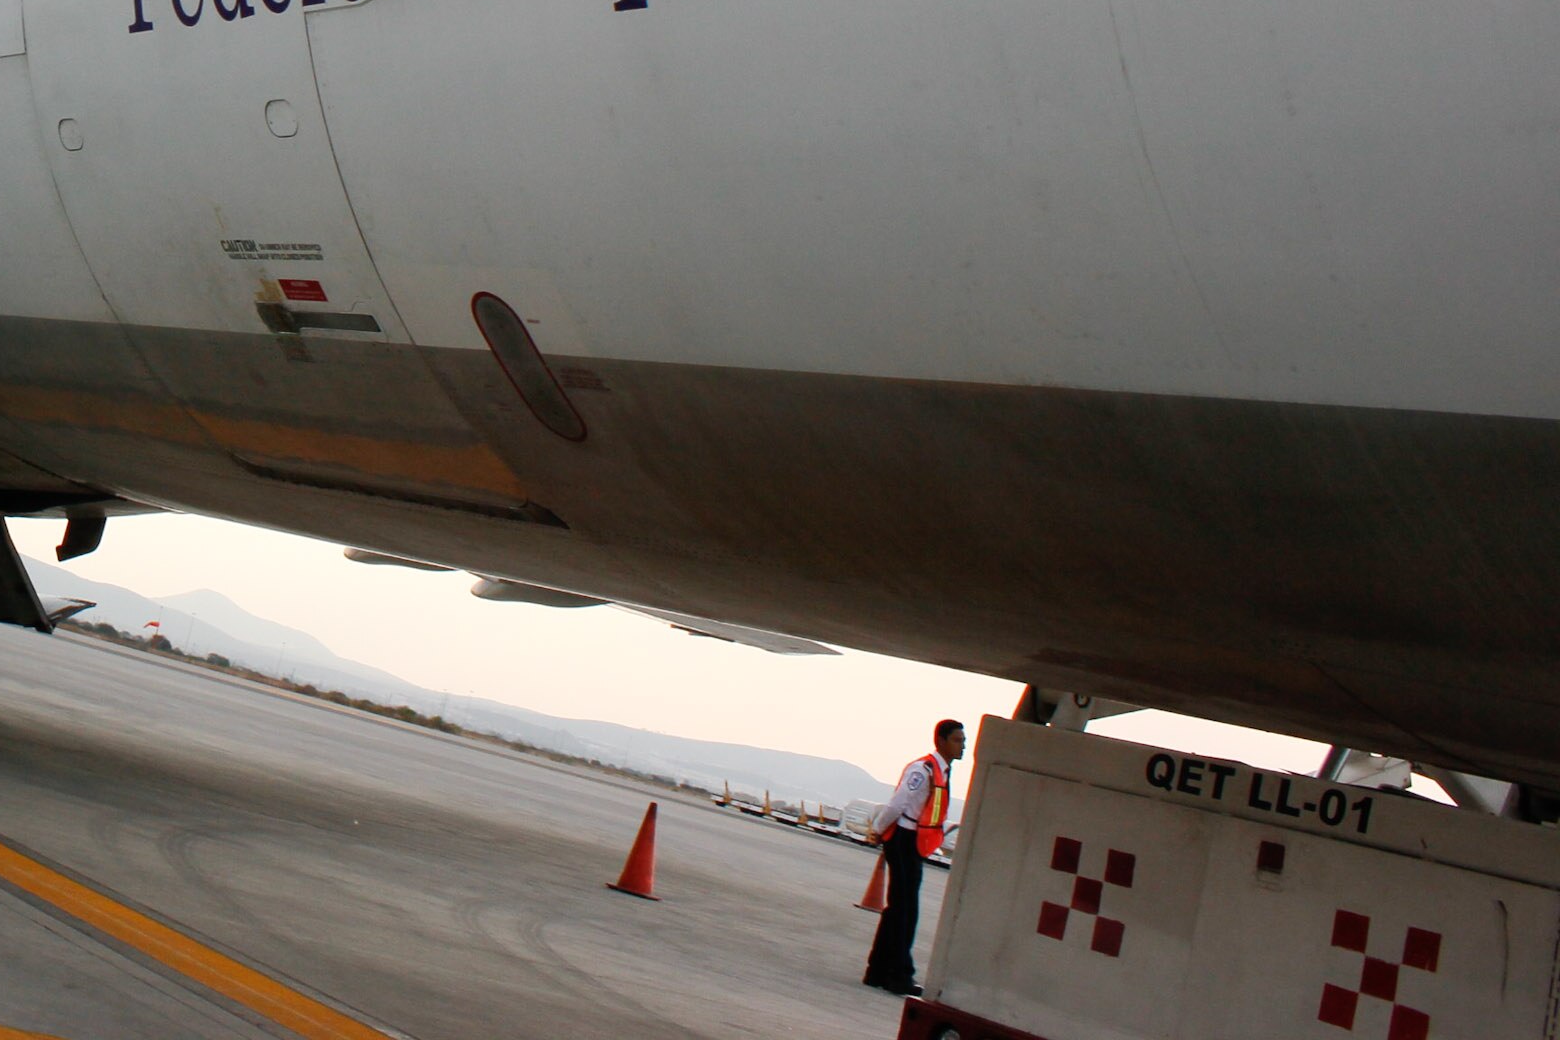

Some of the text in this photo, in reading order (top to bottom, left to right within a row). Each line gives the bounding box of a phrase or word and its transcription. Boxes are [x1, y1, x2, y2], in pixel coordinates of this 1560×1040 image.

[220, 240, 258, 252] CAUTION
[1146, 753, 1373, 834] QET LL-01
